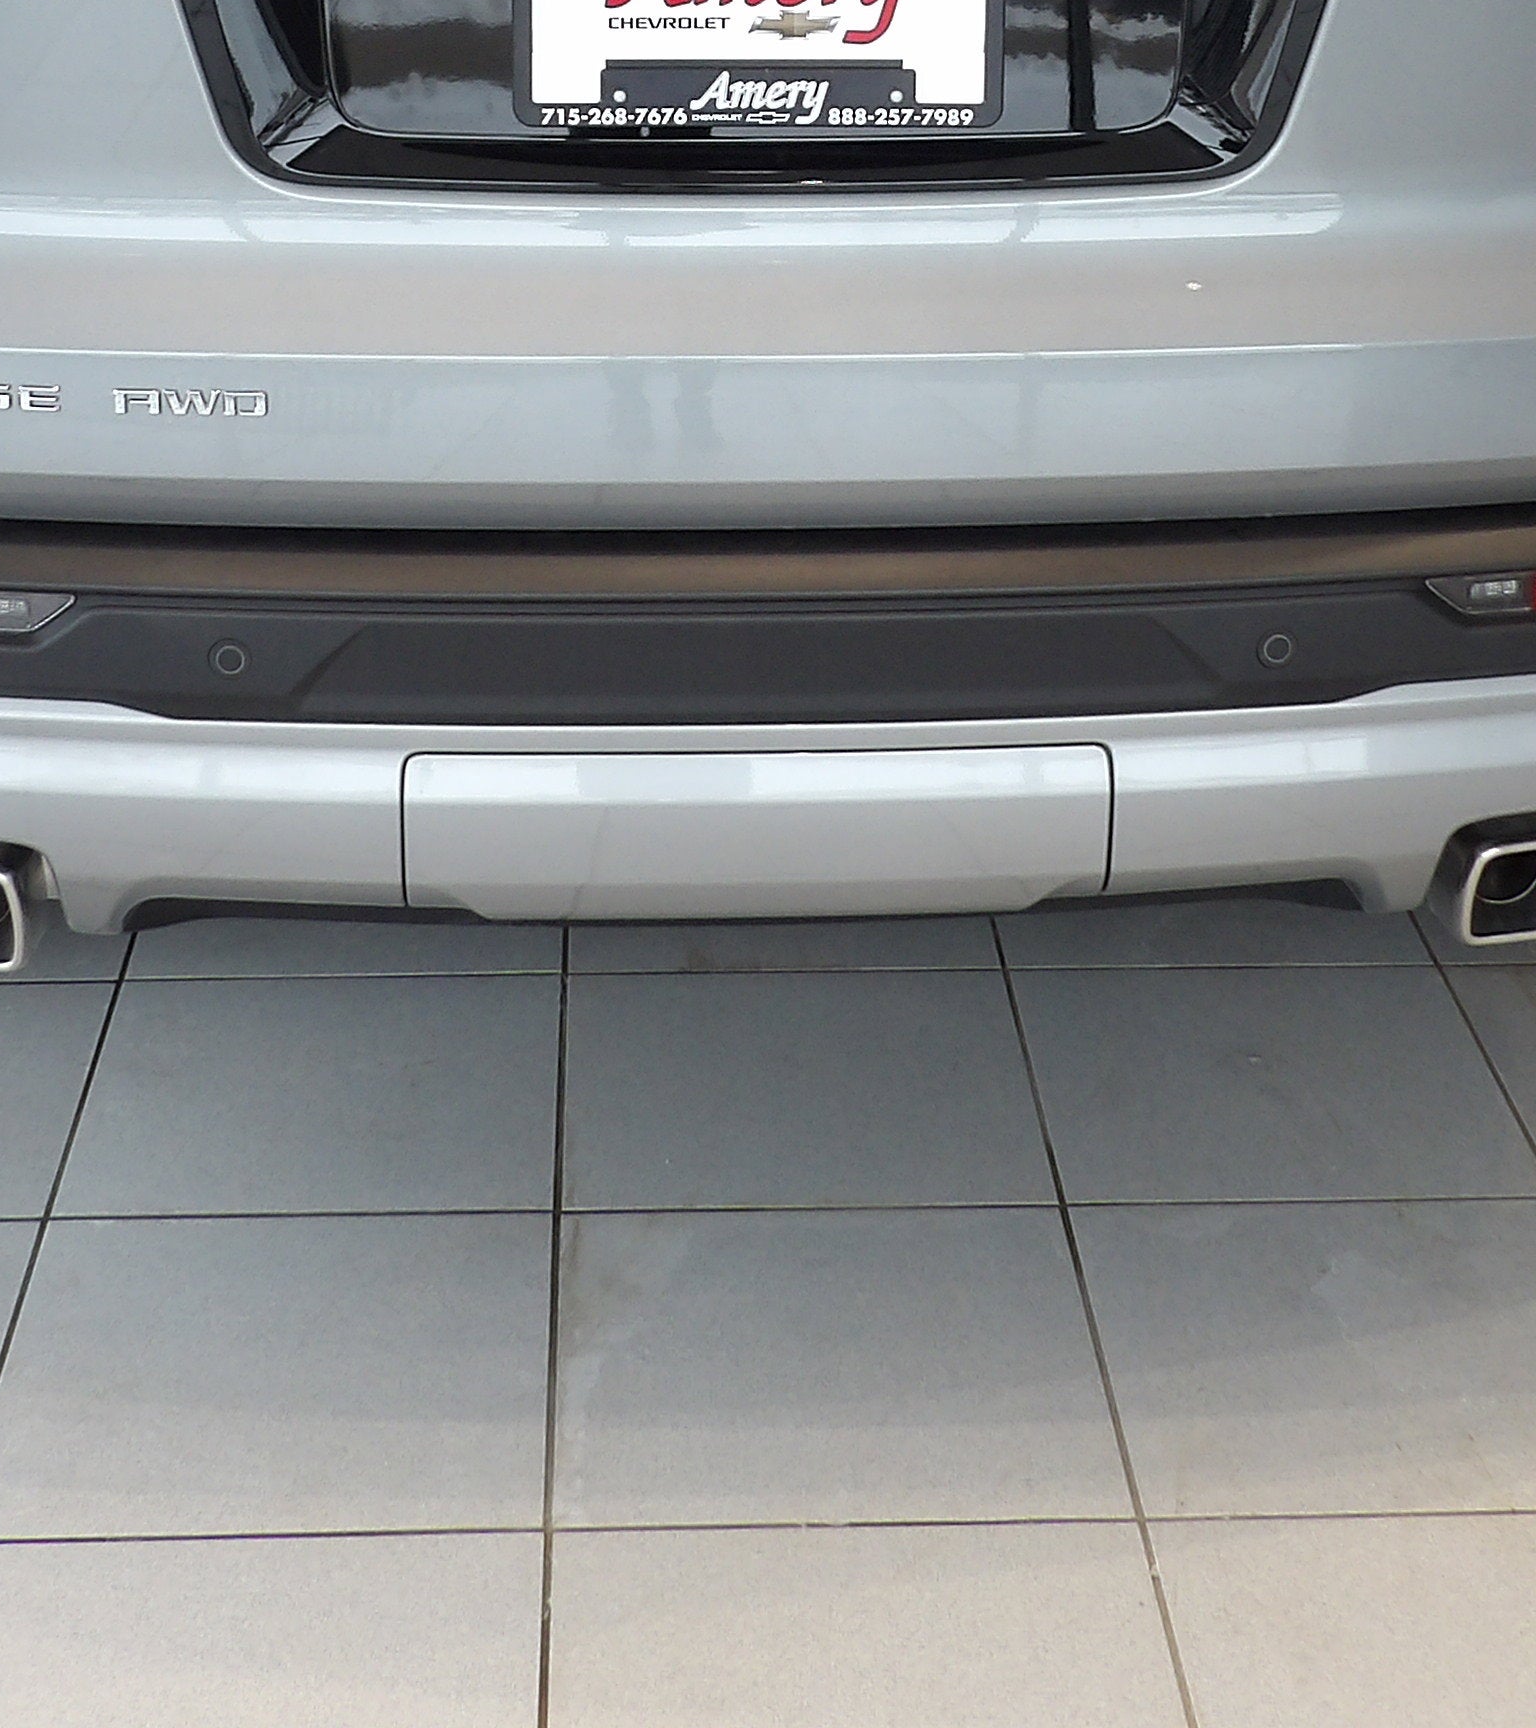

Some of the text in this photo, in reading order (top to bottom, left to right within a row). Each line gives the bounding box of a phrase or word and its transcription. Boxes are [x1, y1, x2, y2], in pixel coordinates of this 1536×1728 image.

[608, 16, 731, 29] CHEVROLET
[690, 71, 829, 125] Amery
[541, 107, 688, 125] 715-268-7676
[828, 107, 974, 126] 888-257-7989
[112, 387, 271, 418] AWD
